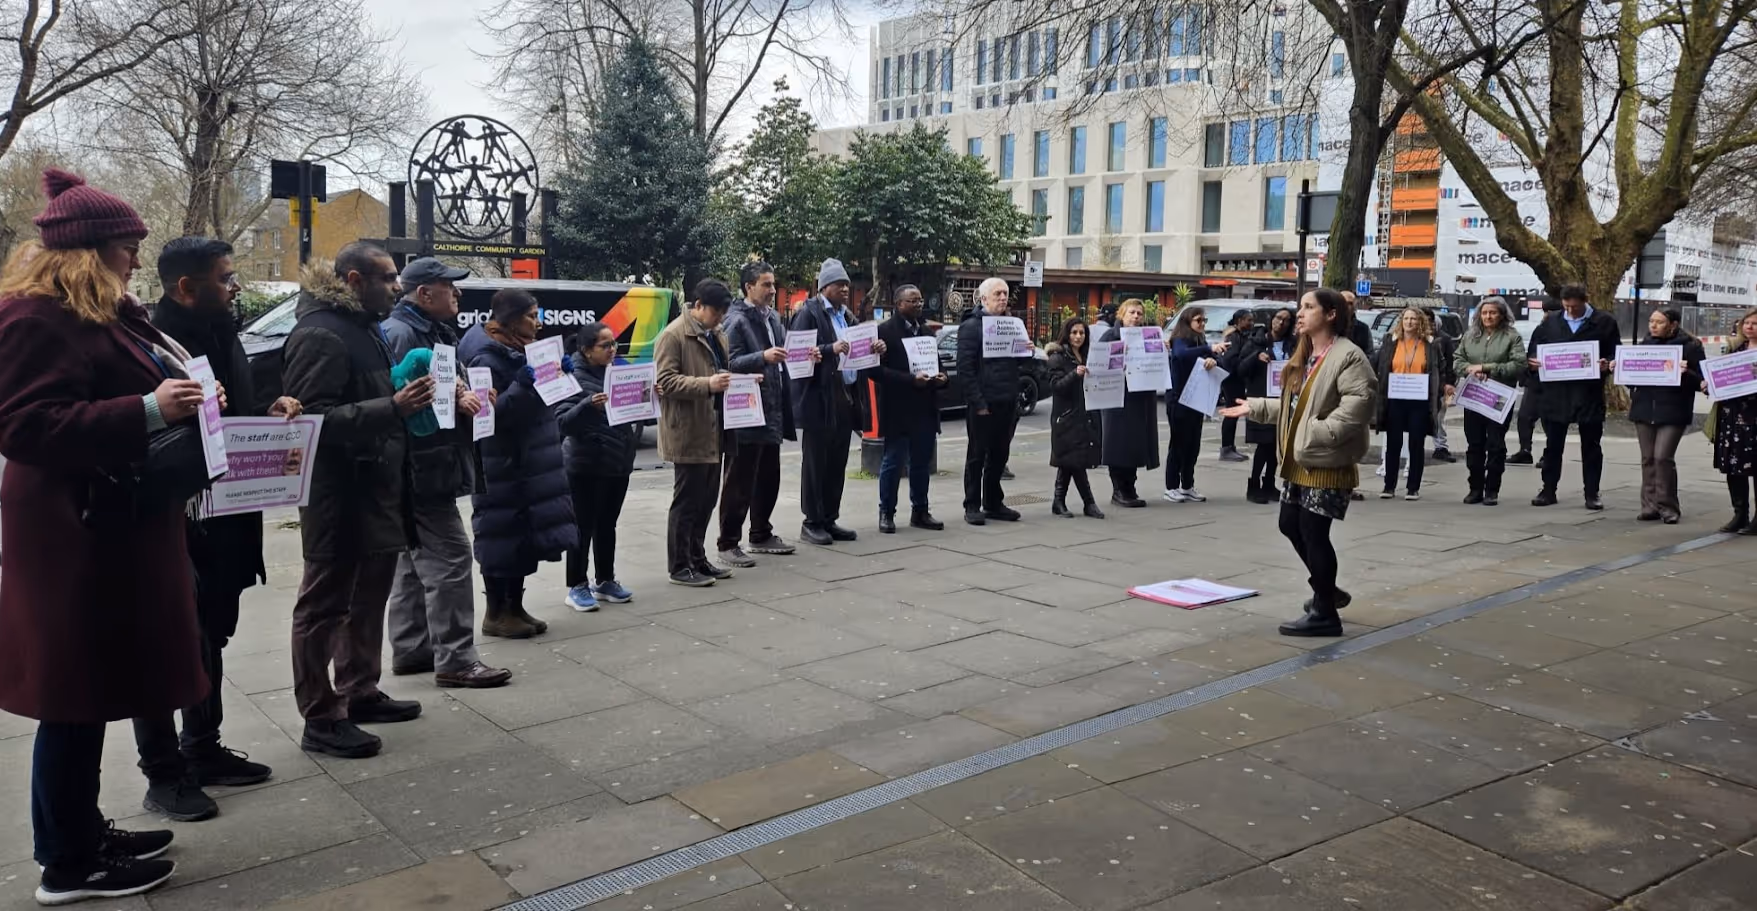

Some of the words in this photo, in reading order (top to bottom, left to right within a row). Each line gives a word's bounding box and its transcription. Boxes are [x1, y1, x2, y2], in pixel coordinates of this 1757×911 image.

[433, 243, 472, 252] CALTHORPE
[475, 245, 516, 254] COMMUNITY
[519, 247, 546, 255] GARDEN
[1458, 253, 1511, 264] mace
[543, 309, 596, 326] SIGNS
[230, 434, 246, 443] The
[247, 432, 270, 443] staff
[243, 453, 267, 463] won't
[267, 454, 284, 464] you
[237, 466, 255, 477] with
